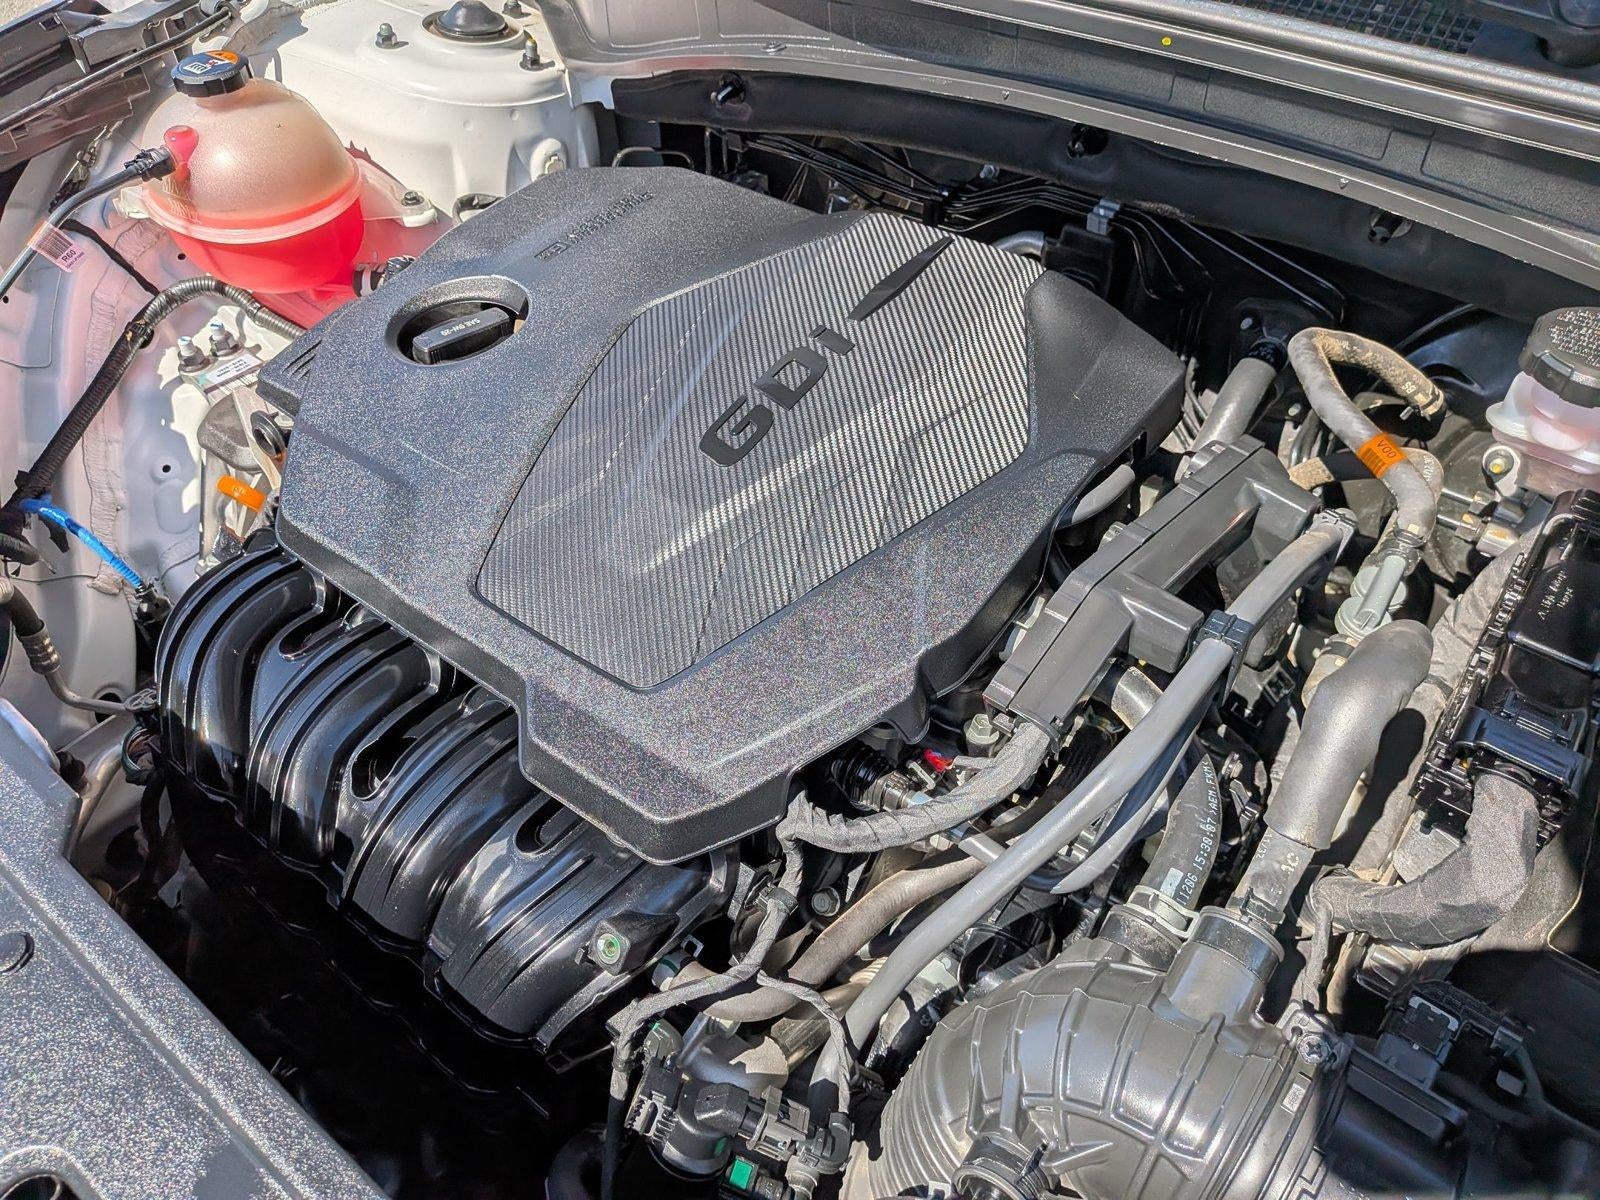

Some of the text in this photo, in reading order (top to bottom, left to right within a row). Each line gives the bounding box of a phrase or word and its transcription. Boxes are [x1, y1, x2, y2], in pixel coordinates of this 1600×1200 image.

[61, 249, 77, 263] R60
[440, 317, 481, 337] SAE 0W-20
[1192, 817, 1217, 872] 15:30:07
